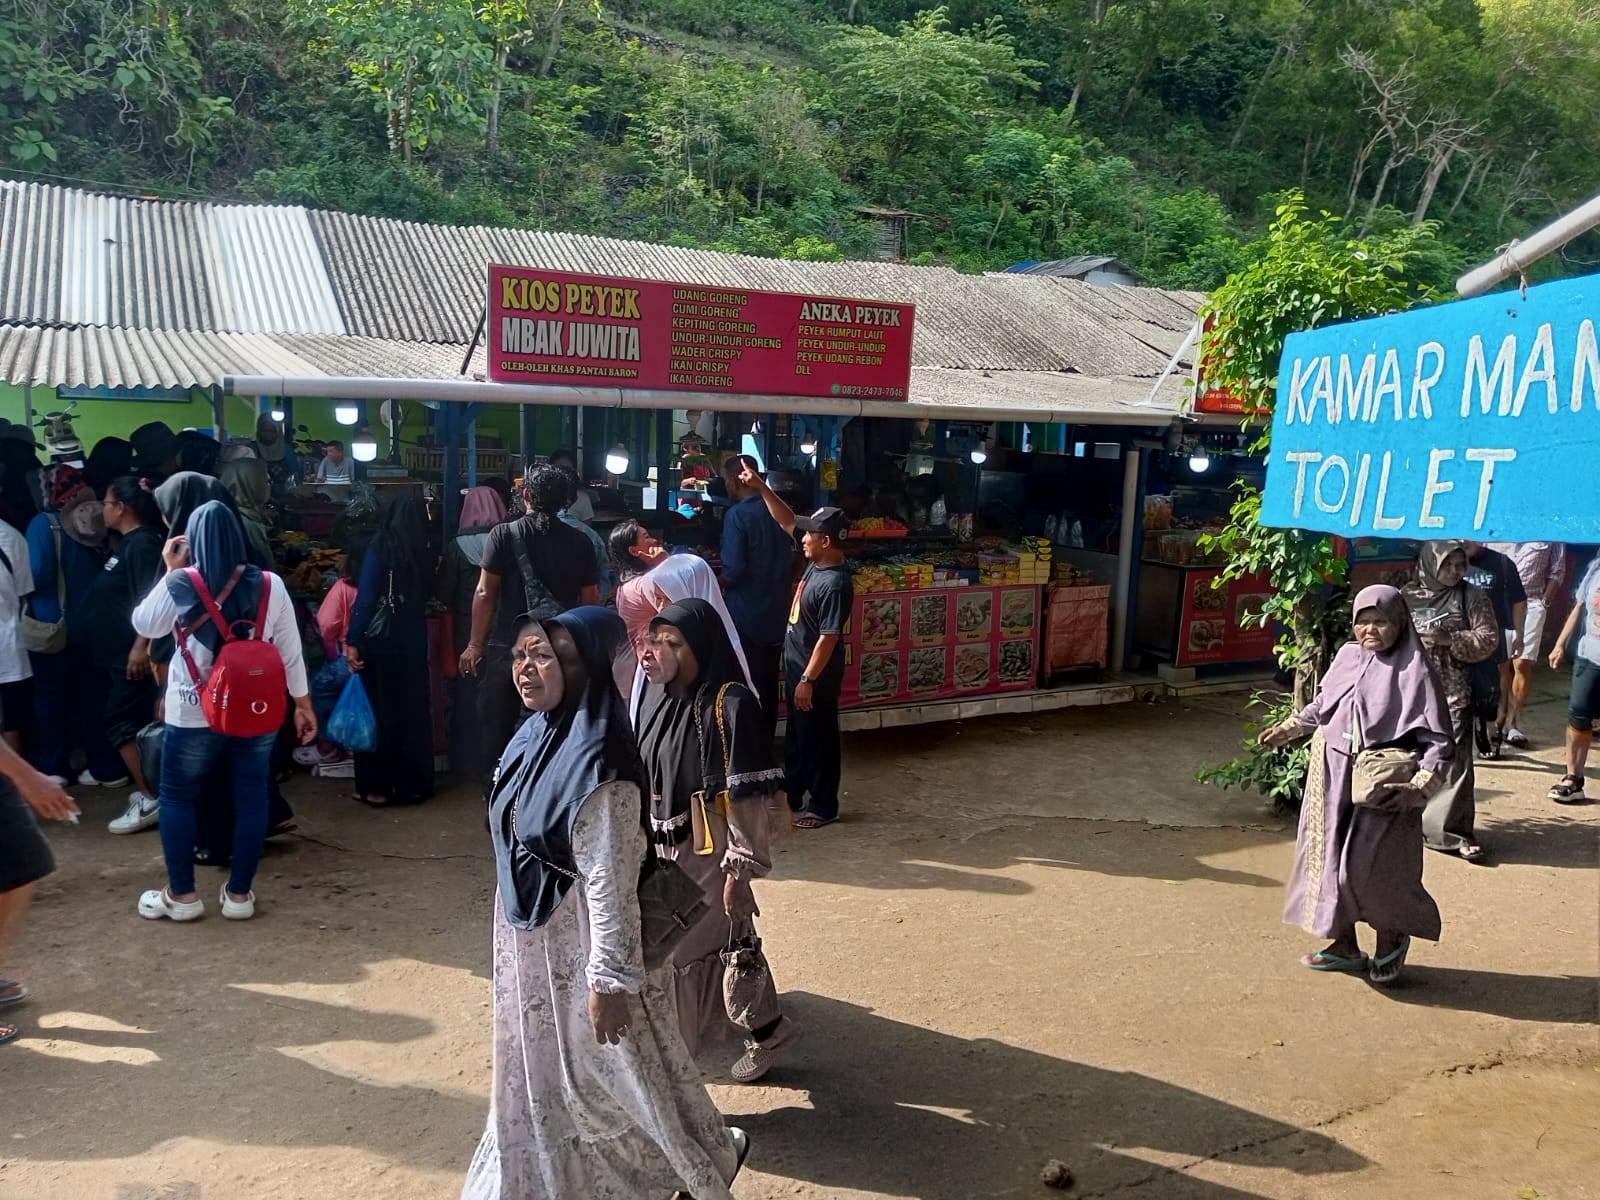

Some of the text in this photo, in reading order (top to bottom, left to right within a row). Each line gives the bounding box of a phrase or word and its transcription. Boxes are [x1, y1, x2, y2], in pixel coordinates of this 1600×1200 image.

[501, 277, 641, 319] KIOS PEYEK
[672, 289, 748, 305] UDANG GORENG
[672, 303, 739, 318] CUMI GORENG
[800, 301, 901, 327] ANEKA PEYEK
[672, 317, 756, 334] KEPITING GORENG
[798, 326, 884, 340] PEYEK RUMPUT LAUT
[501, 317, 641, 361] MBAK JUWITA
[672, 332, 782, 349] UNDUR-UNDUR GORENG
[797, 338, 886, 352] PEYEK UNDUR-UNDUR
[671, 346, 742, 360] WADER CRISPY
[797, 352, 882, 365] PEYEK UDANG REBON
[501, 361, 638, 378] OLEH-OLEH KHAS PANTAI BARON
[670, 359, 730, 374] IKAN CRISPY
[796, 365, 812, 375] DLL
[669, 373, 733, 387] IKAN GORENG
[1286, 341, 1445, 425] KAMAR
[1286, 448, 1518, 531] TOILET
